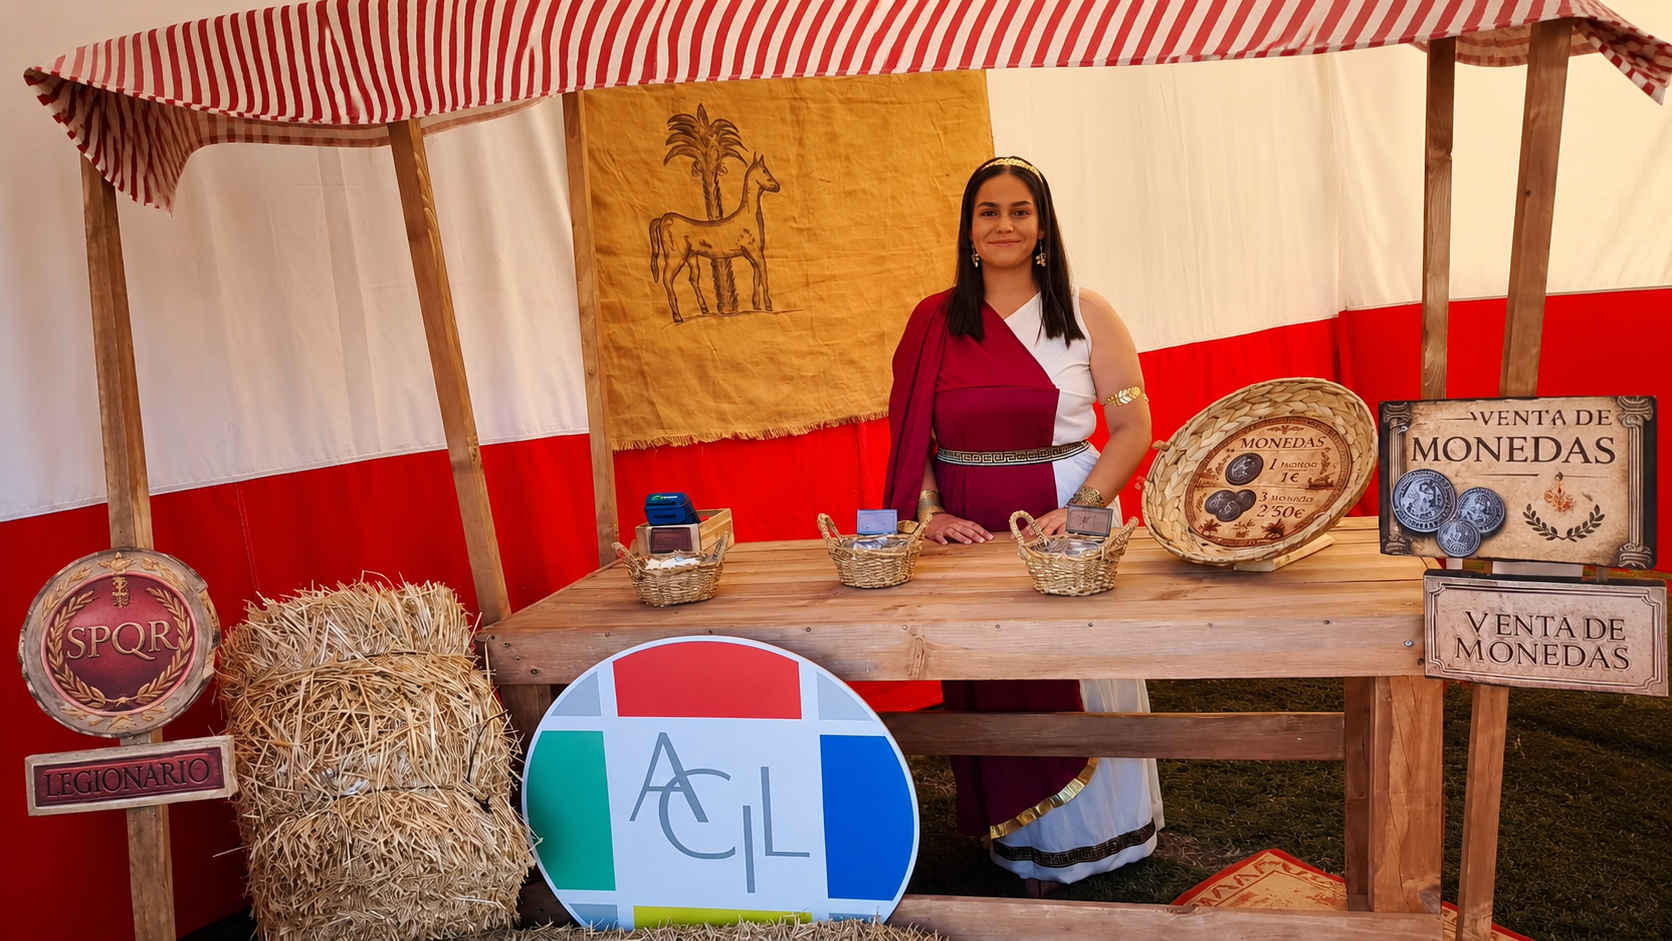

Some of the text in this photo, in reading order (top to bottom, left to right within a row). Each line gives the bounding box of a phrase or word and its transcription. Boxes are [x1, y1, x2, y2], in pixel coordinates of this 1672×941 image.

[1471, 409, 1613, 427] VENTA DE
[1240, 436, 1326, 449] MONEDAS
[1410, 436, 1616, 465] MONEDAS
[1268, 458, 1277, 470] 1
[1281, 472, 1299, 483] 1€
[1259, 491, 1268, 502] 3
[1464, 610, 1627, 641] VENTA DE
[65, 620, 179, 661] SPQR
[1455, 637, 1632, 671] MONEDAS
[45, 757, 210, 798] LEGIONARIO
[629, 731, 811, 893] ACIL
